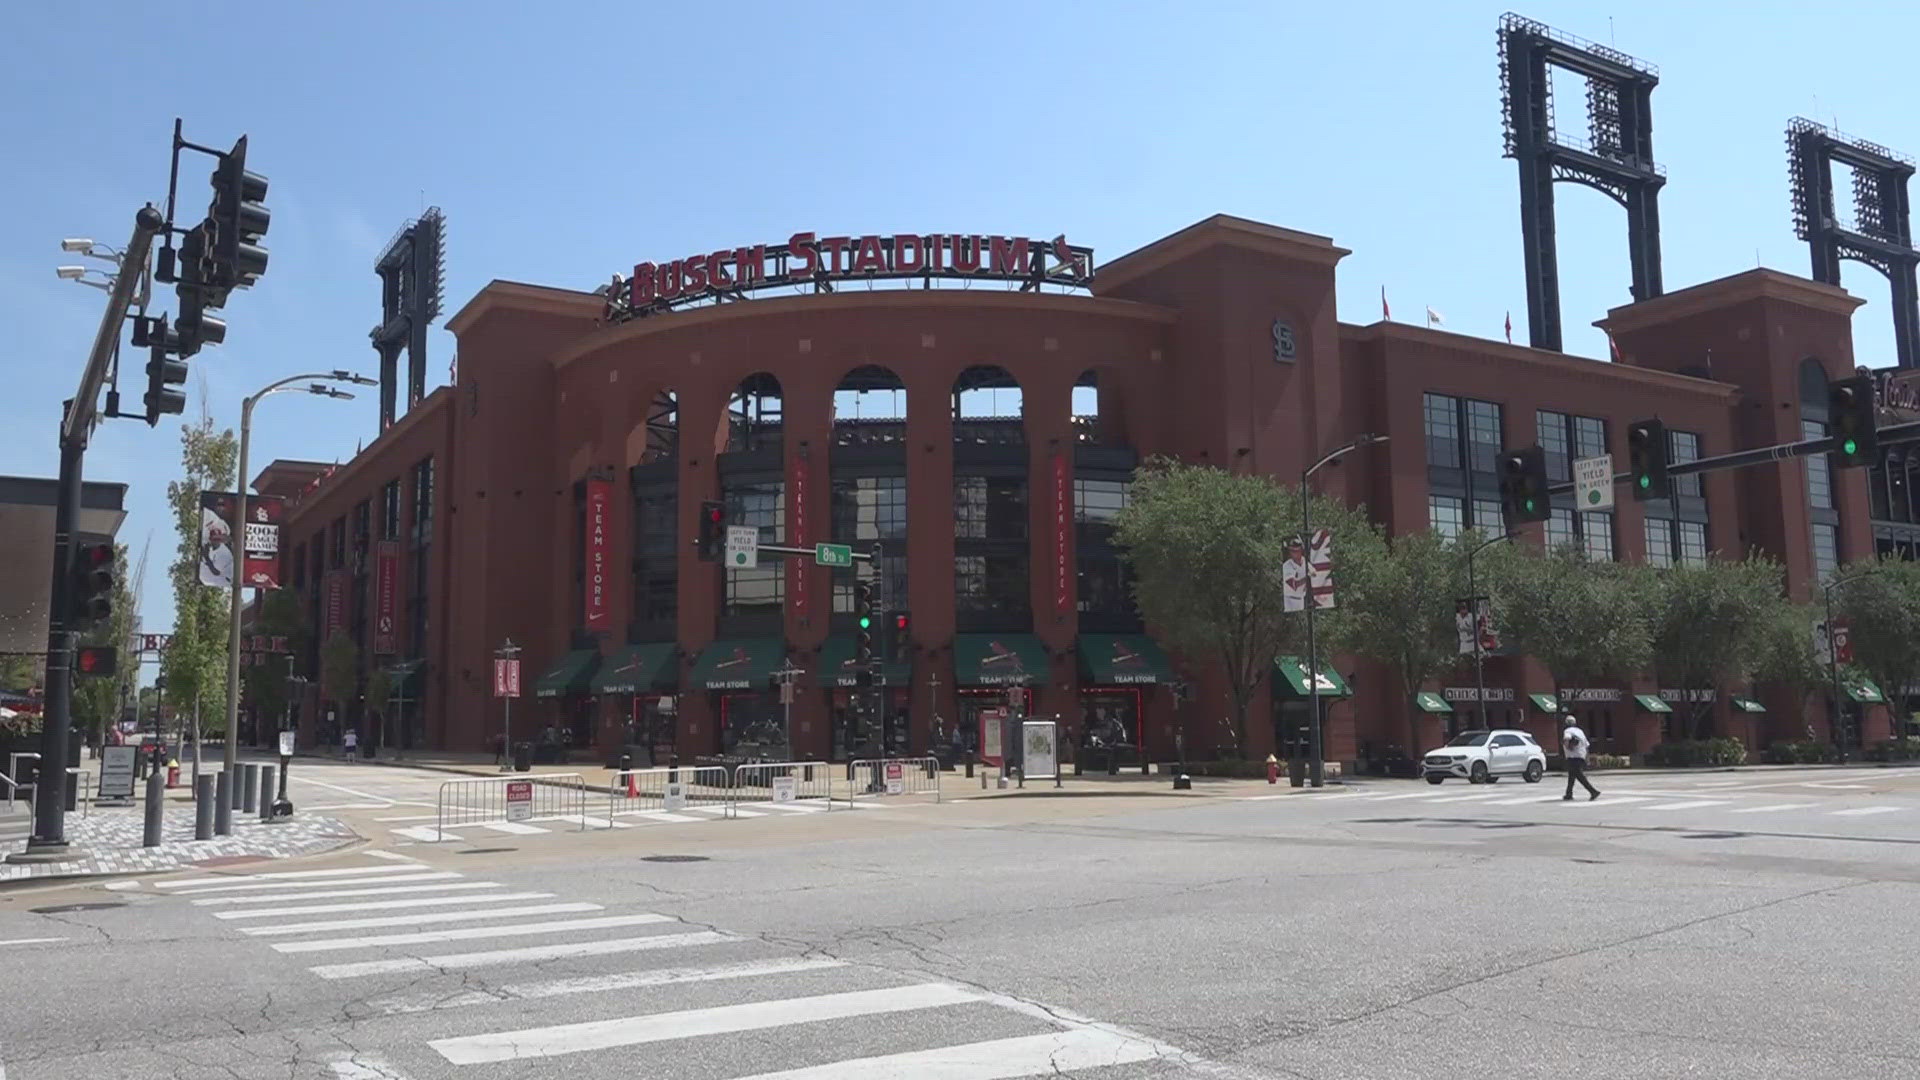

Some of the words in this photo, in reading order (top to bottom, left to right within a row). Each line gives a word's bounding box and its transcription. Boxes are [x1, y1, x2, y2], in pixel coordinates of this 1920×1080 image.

[631, 243, 767, 309] BUSCH
[788, 231, 1030, 279] STADIUM
[1583, 469, 1605, 480] YIELD
[594, 503, 603, 546] TEAM
[734, 536, 751, 545] YIELD
[823, 547, 837, 562] 8th
[594, 552, 603, 606] STORE
[980, 676, 1002, 684] TEAM
[1114, 676, 1134, 684] TEAM
[1135, 676, 1156, 684] STORE
[706, 681, 725, 689] TEAM
[727, 681, 750, 689] STORE
[511, 784, 528, 792] ROAD
[509, 792, 530, 800] CLOSED
